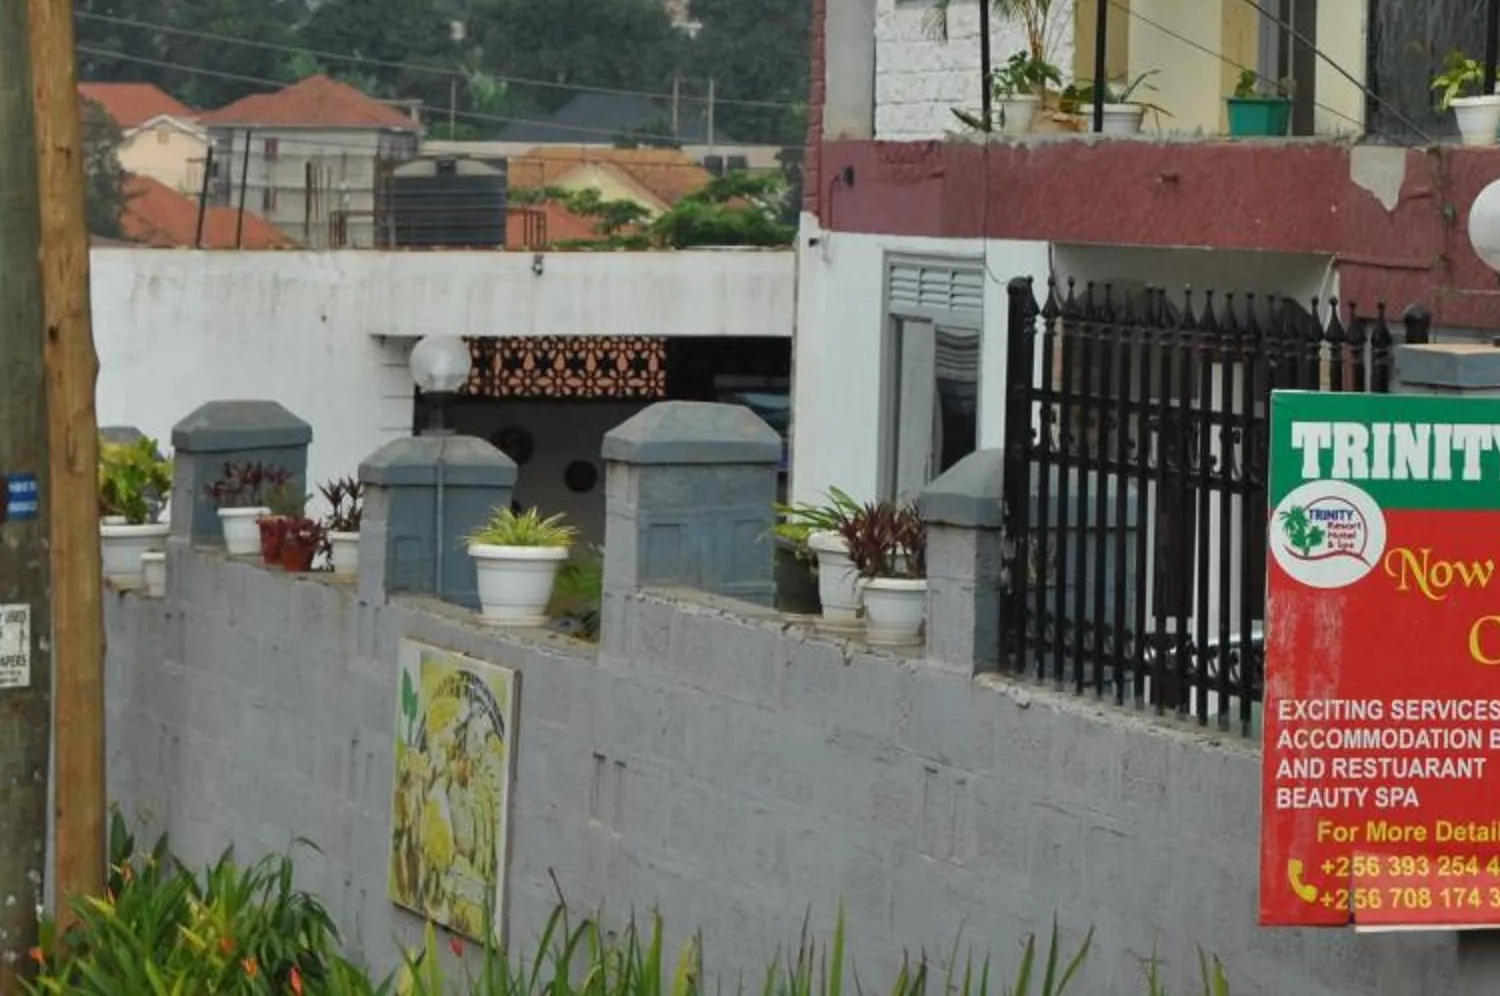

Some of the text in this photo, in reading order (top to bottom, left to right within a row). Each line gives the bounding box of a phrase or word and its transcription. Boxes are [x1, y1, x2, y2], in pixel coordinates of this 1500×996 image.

[1309, 508, 1355, 521] TRINITY
[1384, 546, 1495, 600] Now
[1278, 699, 1384, 721] EXCITING
[1277, 728, 1483, 749] ACCOMMODATION
[1276, 757, 1487, 779] AND RESTUARANT
[1276, 787, 1420, 809] BEAUTY SPA
[1317, 821, 1358, 843] For
[1366, 821, 1428, 843] More
[1320, 856, 1380, 877] +256
[1388, 856, 1430, 877] 393
[1437, 856, 1479, 877] 254
[1320, 888, 1382, 909] +256
[1389, 888, 1432, 909] 708
[1441, 888, 1482, 908] 174
